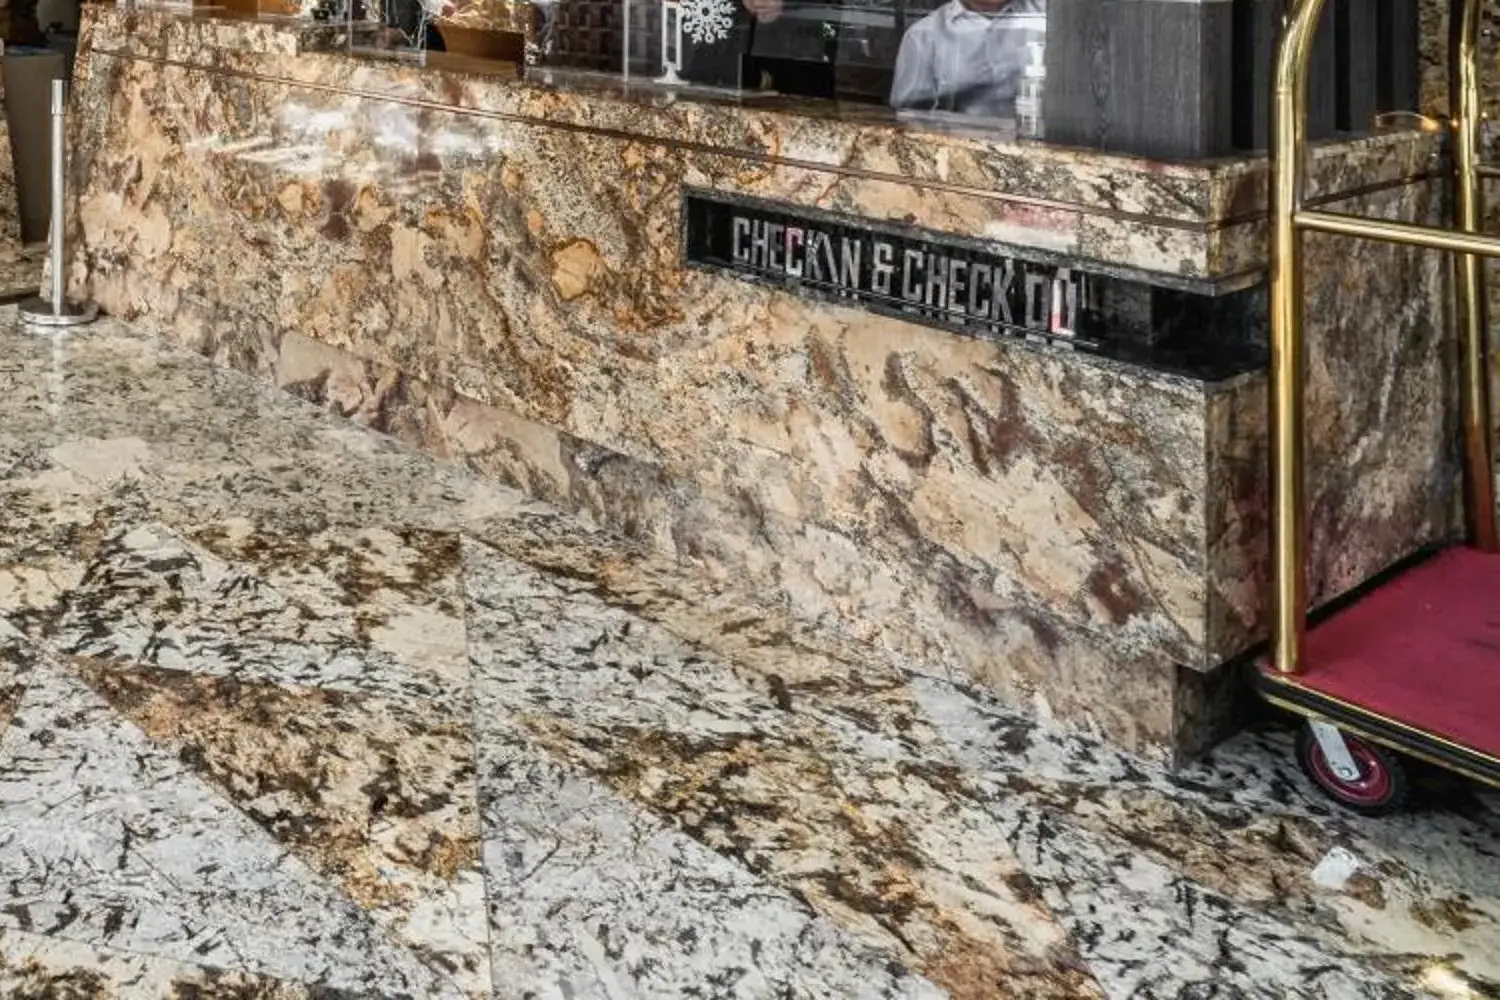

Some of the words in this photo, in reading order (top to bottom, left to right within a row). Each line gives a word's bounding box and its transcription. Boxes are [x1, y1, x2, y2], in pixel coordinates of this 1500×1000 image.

[732, 215, 823, 282] CHECK
[872, 240, 894, 296] &
[902, 248, 1014, 325] CHECK
